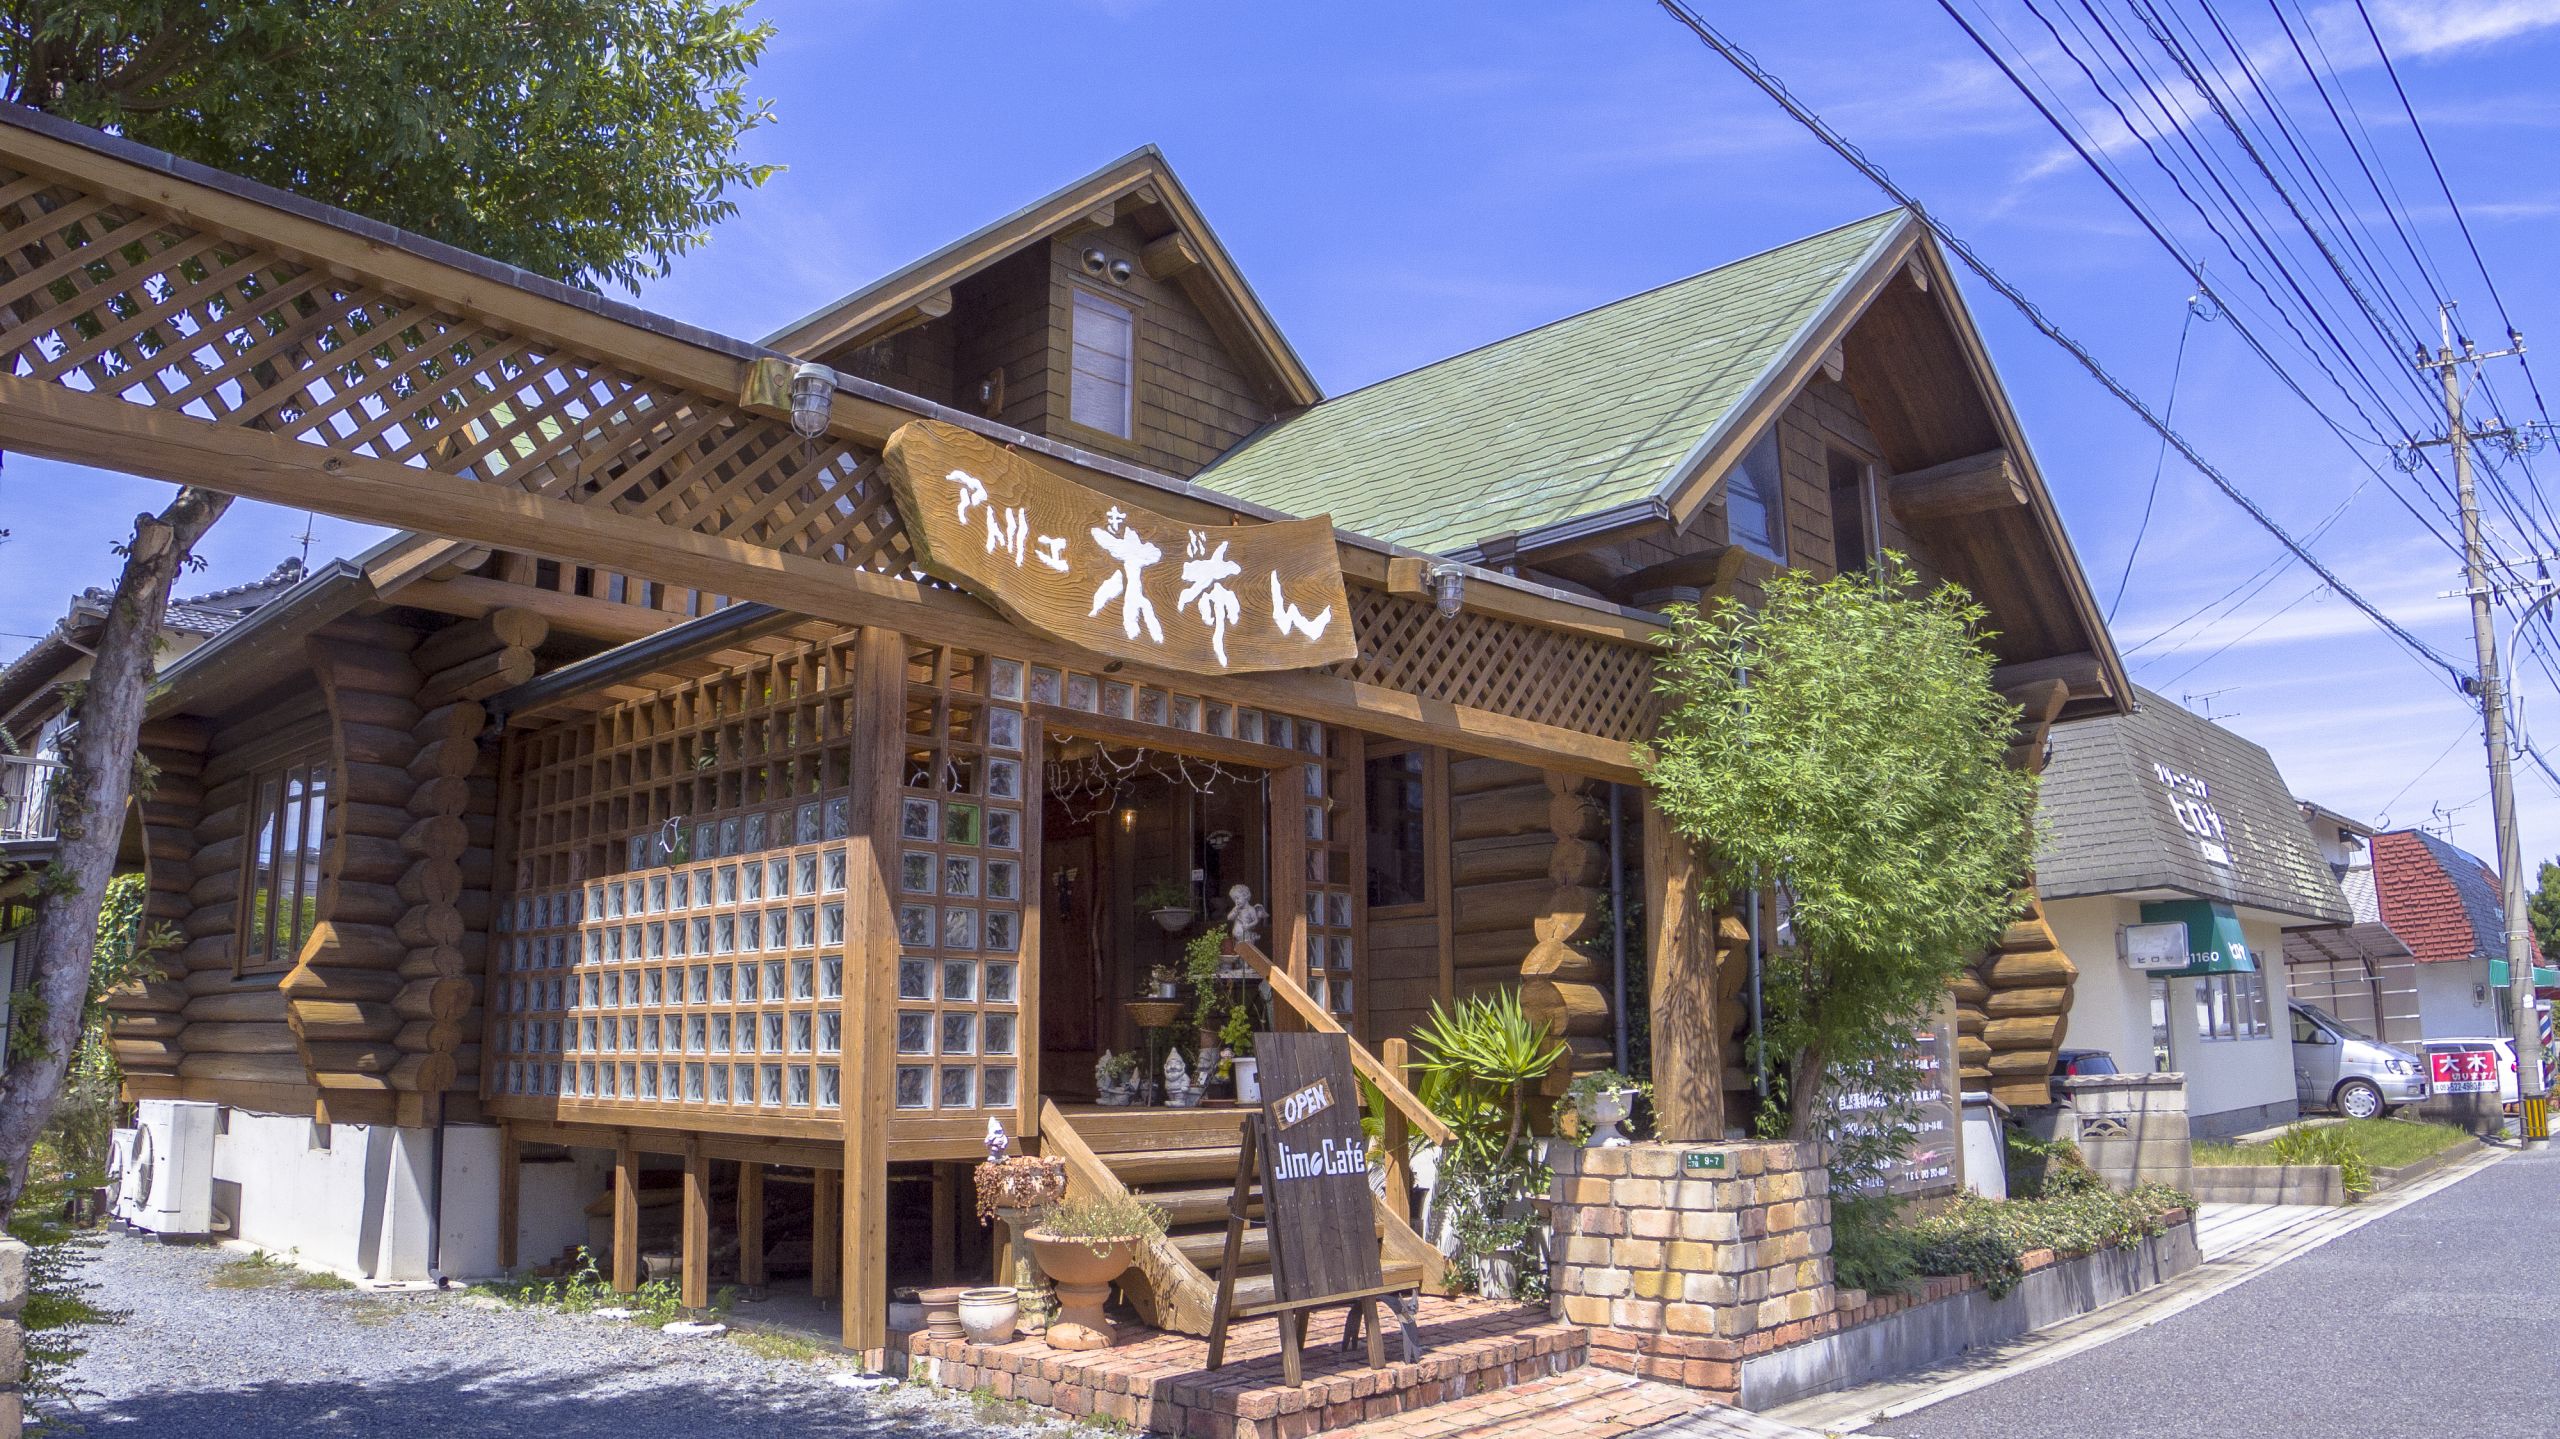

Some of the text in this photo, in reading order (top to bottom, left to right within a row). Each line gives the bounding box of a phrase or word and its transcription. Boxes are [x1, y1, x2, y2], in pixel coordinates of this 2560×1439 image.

[2438, 1053, 2488, 1073] 大木
[1284, 1083, 1328, 1124] OPEN
[1321, 1137, 1365, 1176] Café
[1704, 1156, 1720, 1166] 9-7
